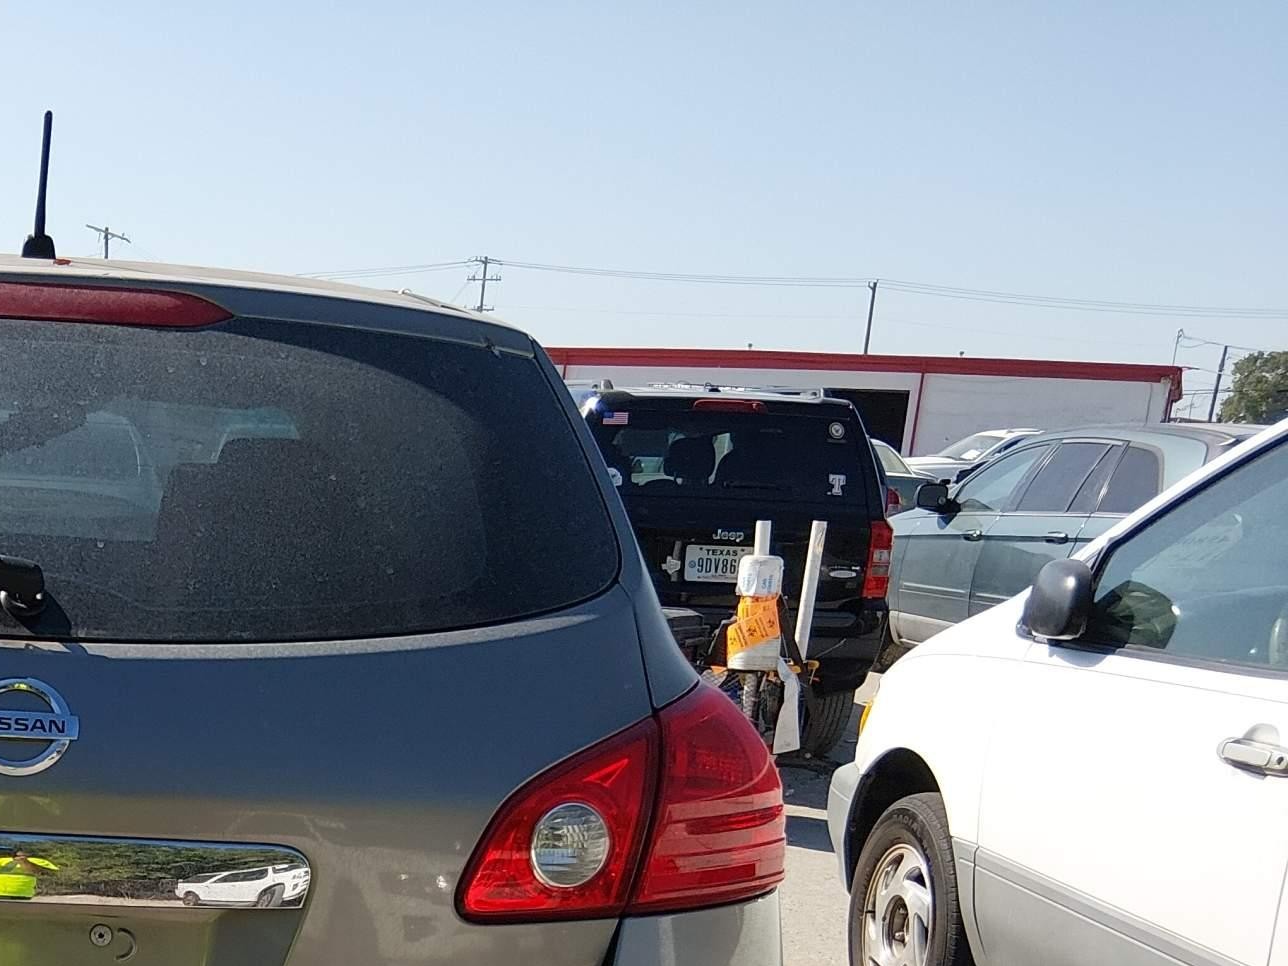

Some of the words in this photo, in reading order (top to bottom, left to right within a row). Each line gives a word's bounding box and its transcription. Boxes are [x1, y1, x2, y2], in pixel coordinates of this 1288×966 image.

[713, 529, 744, 542] Jeep
[706, 548, 738, 557] TEXAS
[697, 557, 739, 574] 9DV86
